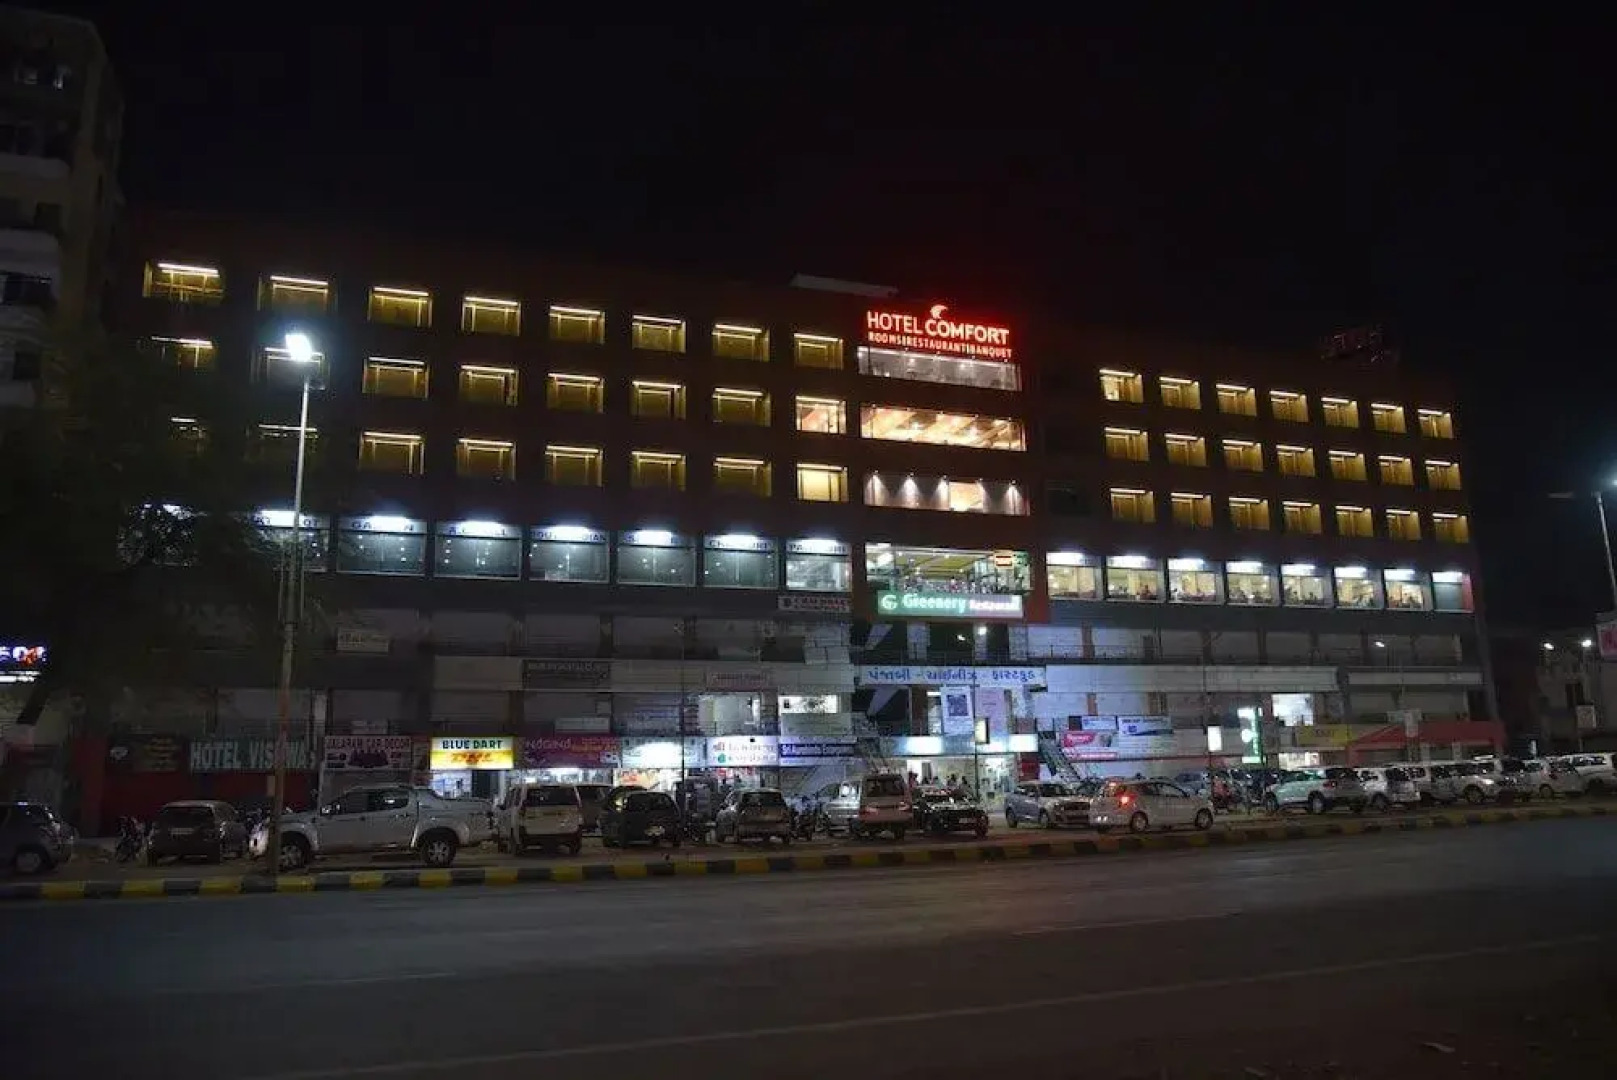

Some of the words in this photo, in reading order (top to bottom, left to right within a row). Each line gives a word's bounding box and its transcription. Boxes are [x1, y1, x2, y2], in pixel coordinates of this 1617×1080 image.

[867, 311, 923, 335] HOTEL
[925, 319, 1010, 345] COMFORT
[902, 593, 966, 613] Greenery
[190, 741, 242, 769] HOTEL
[442, 739, 471, 750] BLUE
[473, 739, 504, 750] DART
